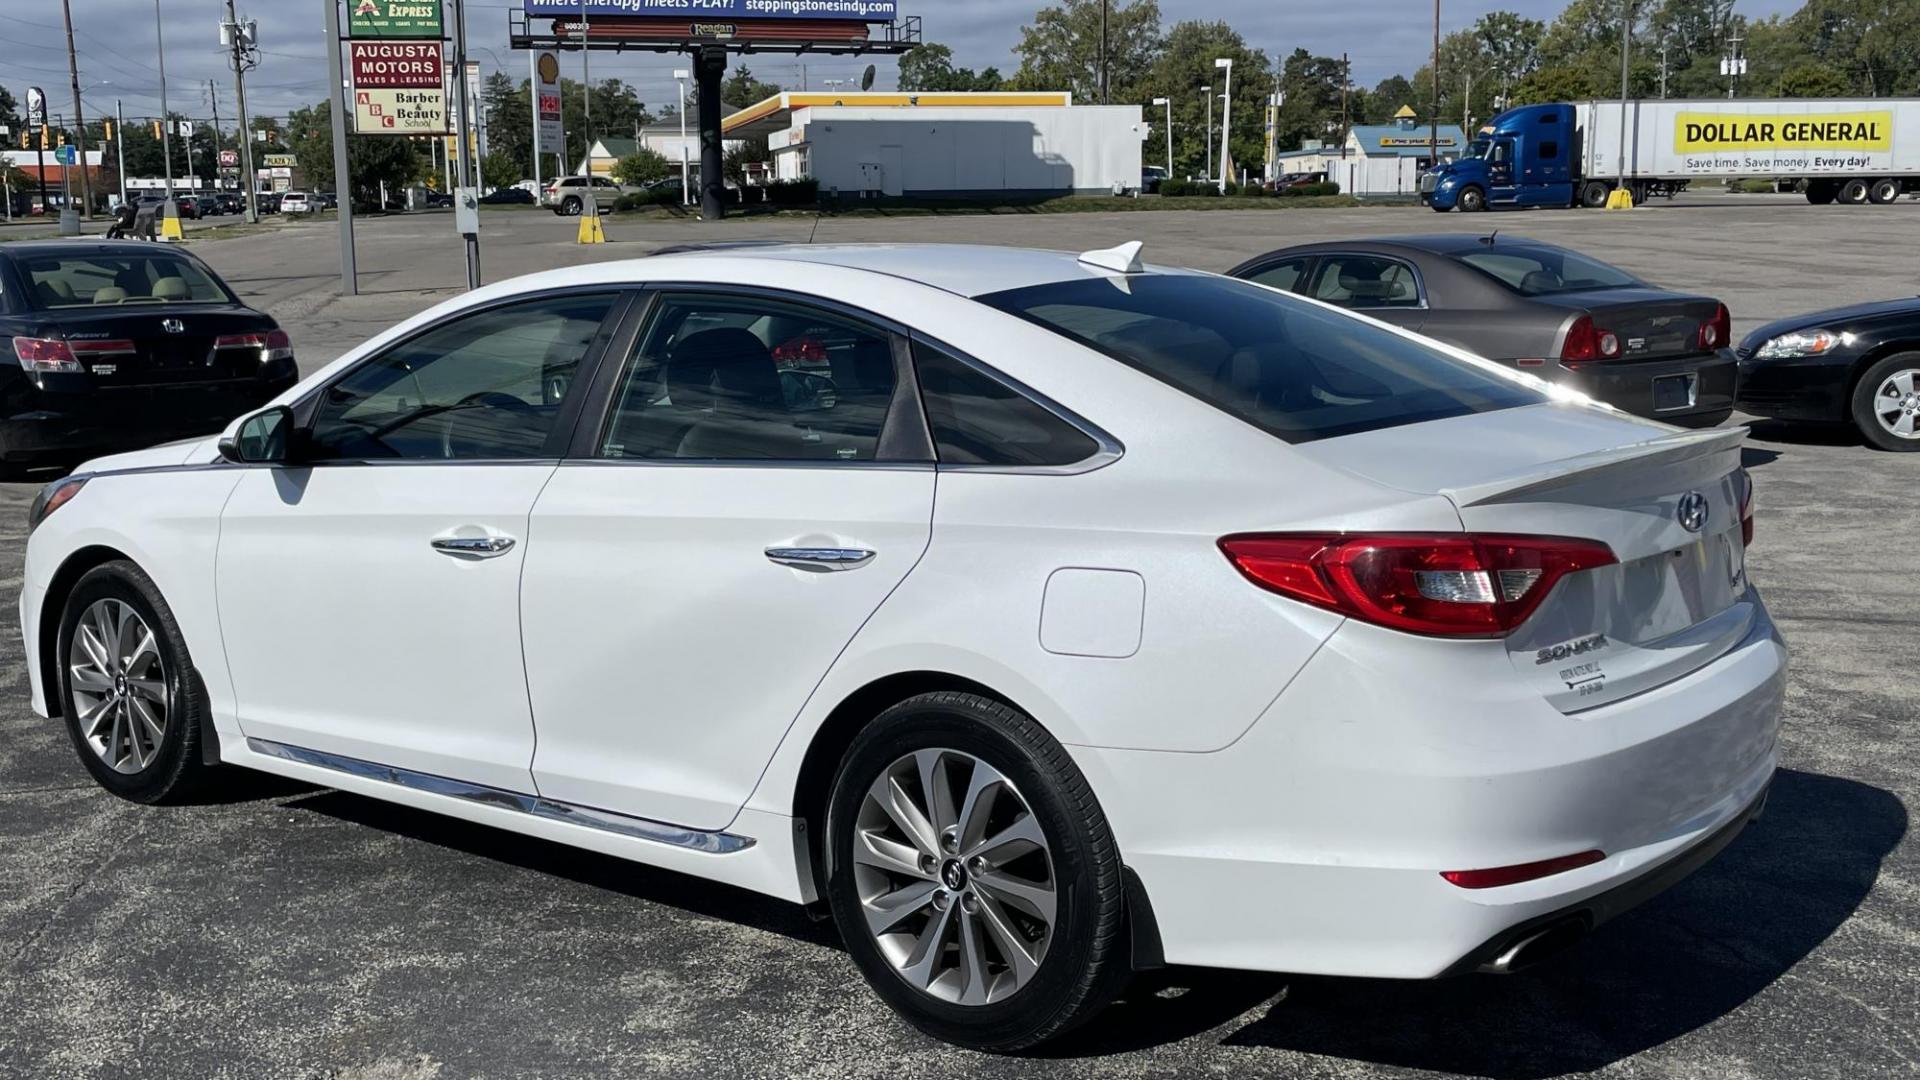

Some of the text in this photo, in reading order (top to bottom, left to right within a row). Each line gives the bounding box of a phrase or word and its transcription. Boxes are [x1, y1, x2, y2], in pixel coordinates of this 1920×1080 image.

[692, 0, 735, 8] PLAY!
[746, 0, 894, 15] steppingstonesindy.com
[356, 46, 438, 58] AUGUSTA
[361, 62, 434, 74] MOTORS
[396, 92, 440, 103] Barber
[397, 109, 441, 121] Beauty
[404, 119, 432, 128] School
[1686, 123, 1881, 142] DOLLAR GENERAL
[1687, 157, 1712, 168] Save
[1745, 157, 1770, 167] Save
[1815, 157, 1845, 167] Every
[1847, 156, 1870, 167] day!
[1536, 634, 1608, 665] SONATA
